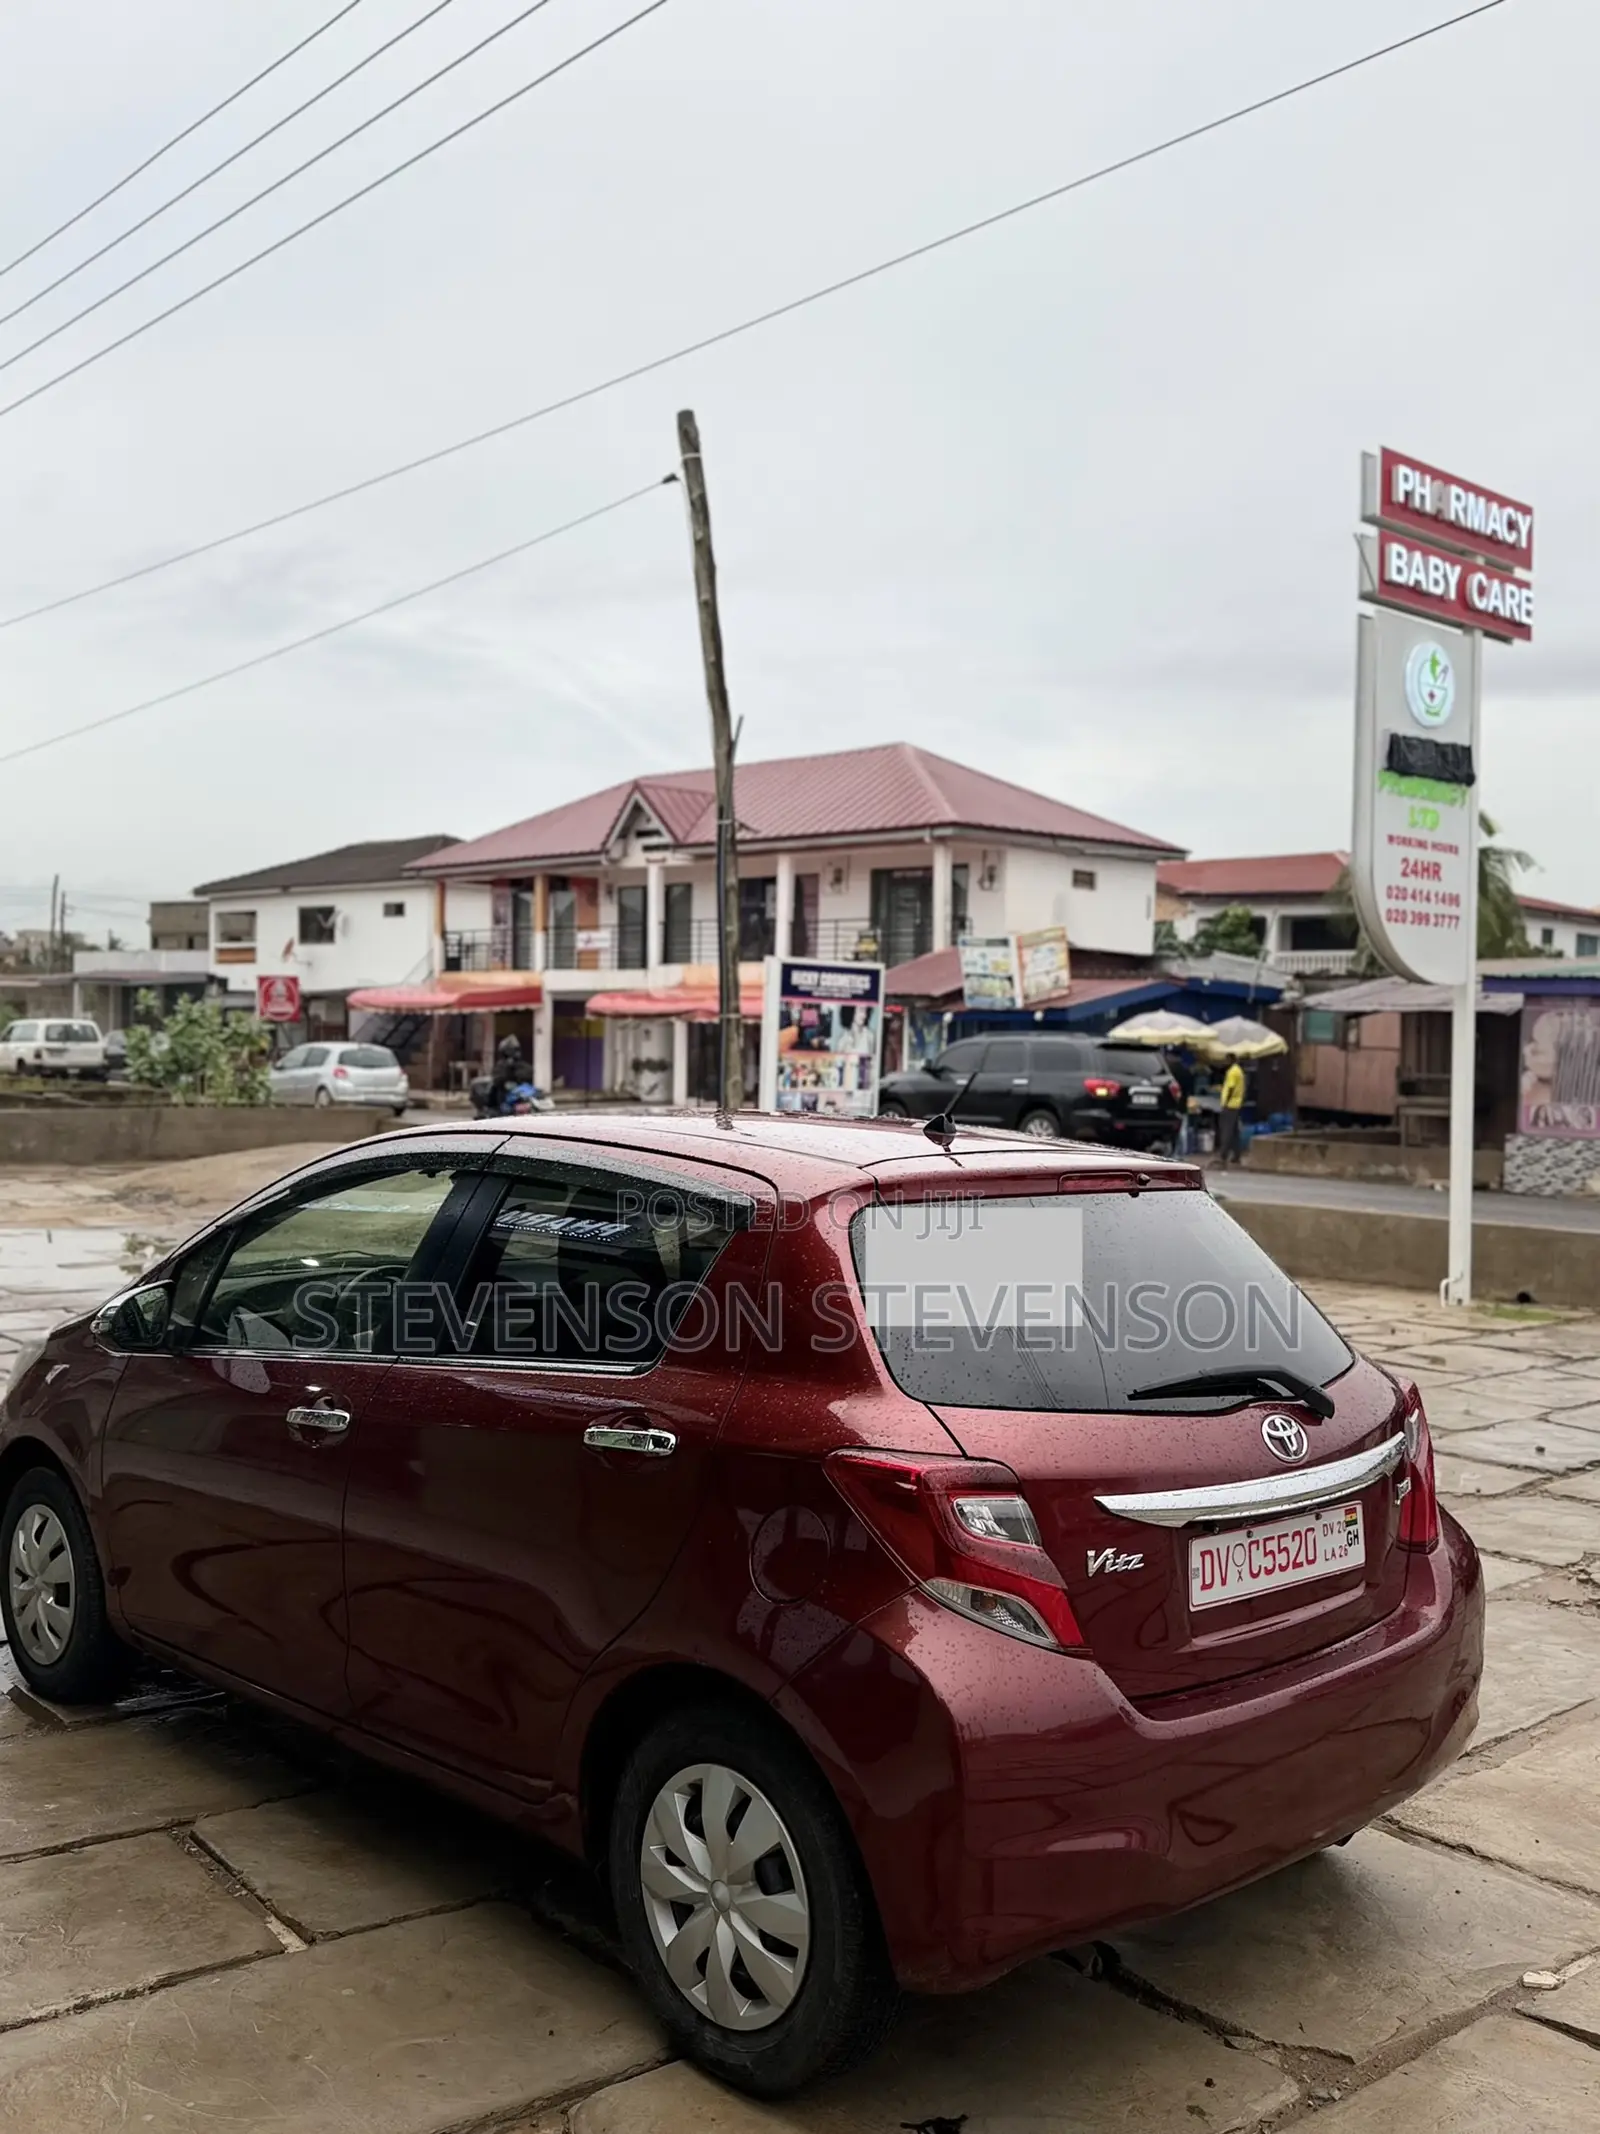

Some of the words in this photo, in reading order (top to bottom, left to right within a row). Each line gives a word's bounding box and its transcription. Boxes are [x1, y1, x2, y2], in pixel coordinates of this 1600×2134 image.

[1392, 464, 1532, 549] PHARMACY
[1385, 543, 1462, 601] BABY
[1466, 571, 1535, 626] CARE
[1400, 857, 1442, 882] 24HR
[1322, 1521, 1335, 1538] DV
[1346, 1528, 1360, 1548] GH
[1086, 1547, 1145, 1578] Vitz
[1200, 1545, 1230, 1592] DV
[1248, 1527, 1318, 1580] C5520
[1324, 1546, 1337, 1562] LA
